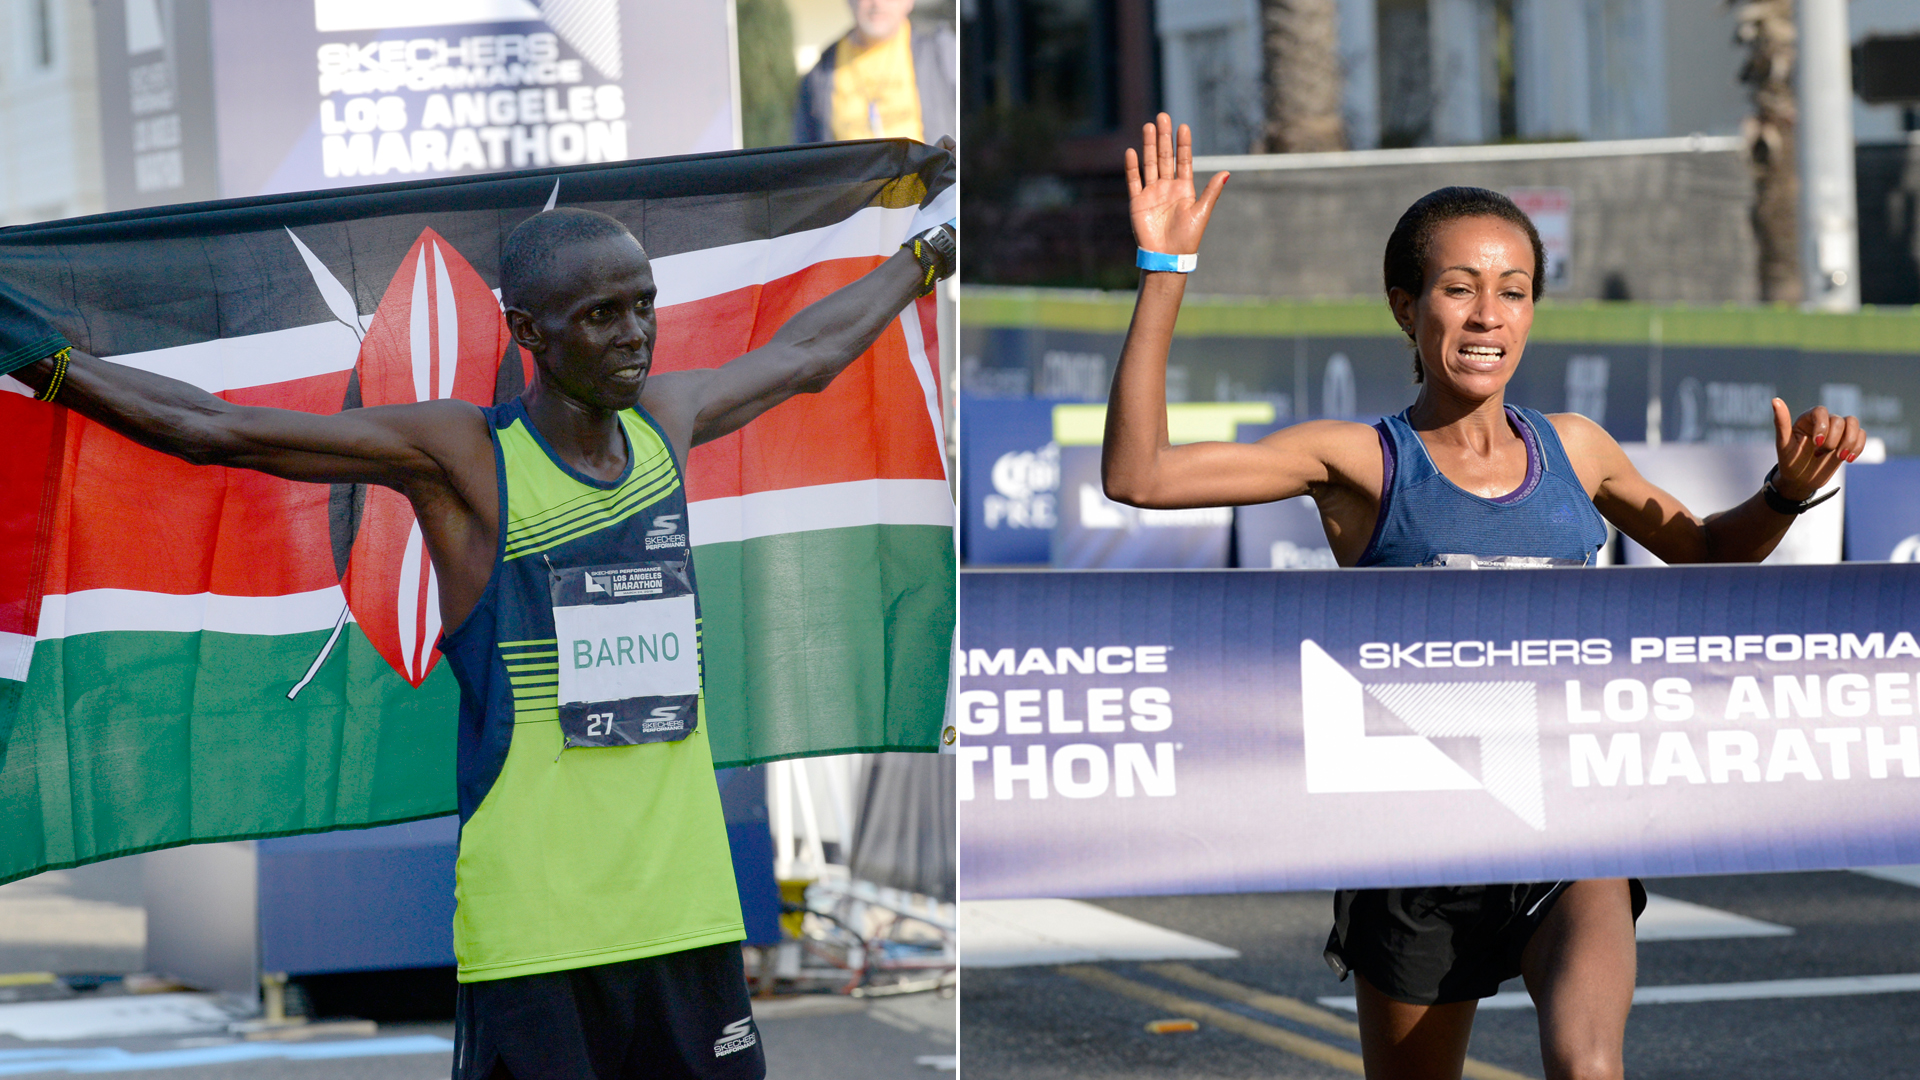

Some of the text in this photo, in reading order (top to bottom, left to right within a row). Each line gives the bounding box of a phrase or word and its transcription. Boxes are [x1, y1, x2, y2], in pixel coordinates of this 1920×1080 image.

[317, 32, 558, 73] SKECHERS
[319, 59, 582, 95] PERFORMANCE
[320, 84, 625, 135] LOS ANGELES
[322, 120, 629, 178] MARATHON
[645, 534, 686, 545] SKECHERS
[645, 542, 686, 551] PERFORMANCE
[613, 580, 663, 591] MARATHON
[620, 566, 661, 574] PERFORMANCE
[629, 572, 662, 581] ANGELES
[573, 632, 680, 670] BARNO
[960, 645, 1168, 677] MANCE
[1359, 632, 1920, 670] SKECHERS PERFORMA
[960, 687, 1173, 736] GELES
[1565, 672, 1920, 724] LOS ANGE
[587, 712, 614, 736] 27
[642, 720, 685, 729] SKECHERS
[1568, 725, 1920, 788] MARATH
